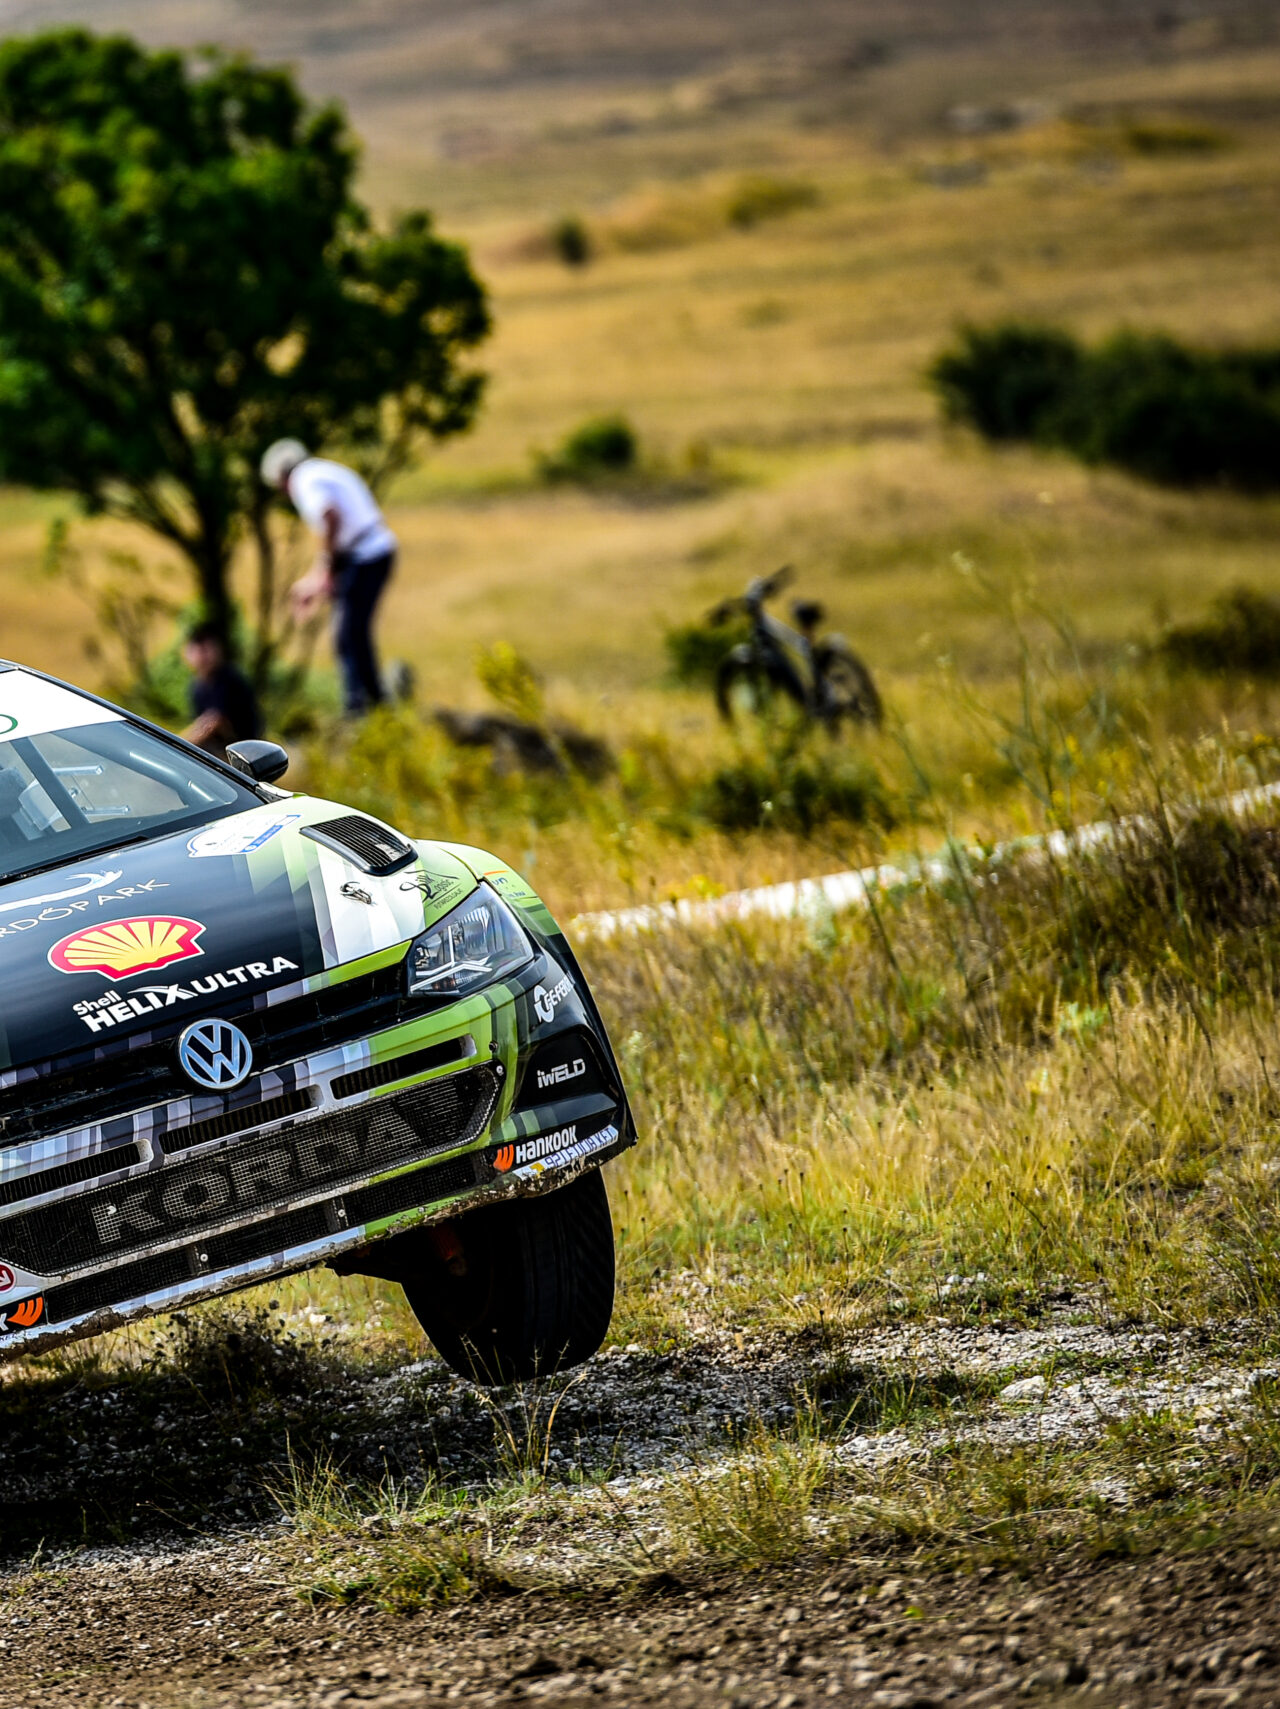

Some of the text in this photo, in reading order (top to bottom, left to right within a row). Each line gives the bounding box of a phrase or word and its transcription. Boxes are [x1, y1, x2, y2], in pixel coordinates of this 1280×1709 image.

[72, 990, 122, 1017] Shell
[80, 955, 299, 1033] HELIX ULTRA
[93, 1099, 421, 1244] KORDA
